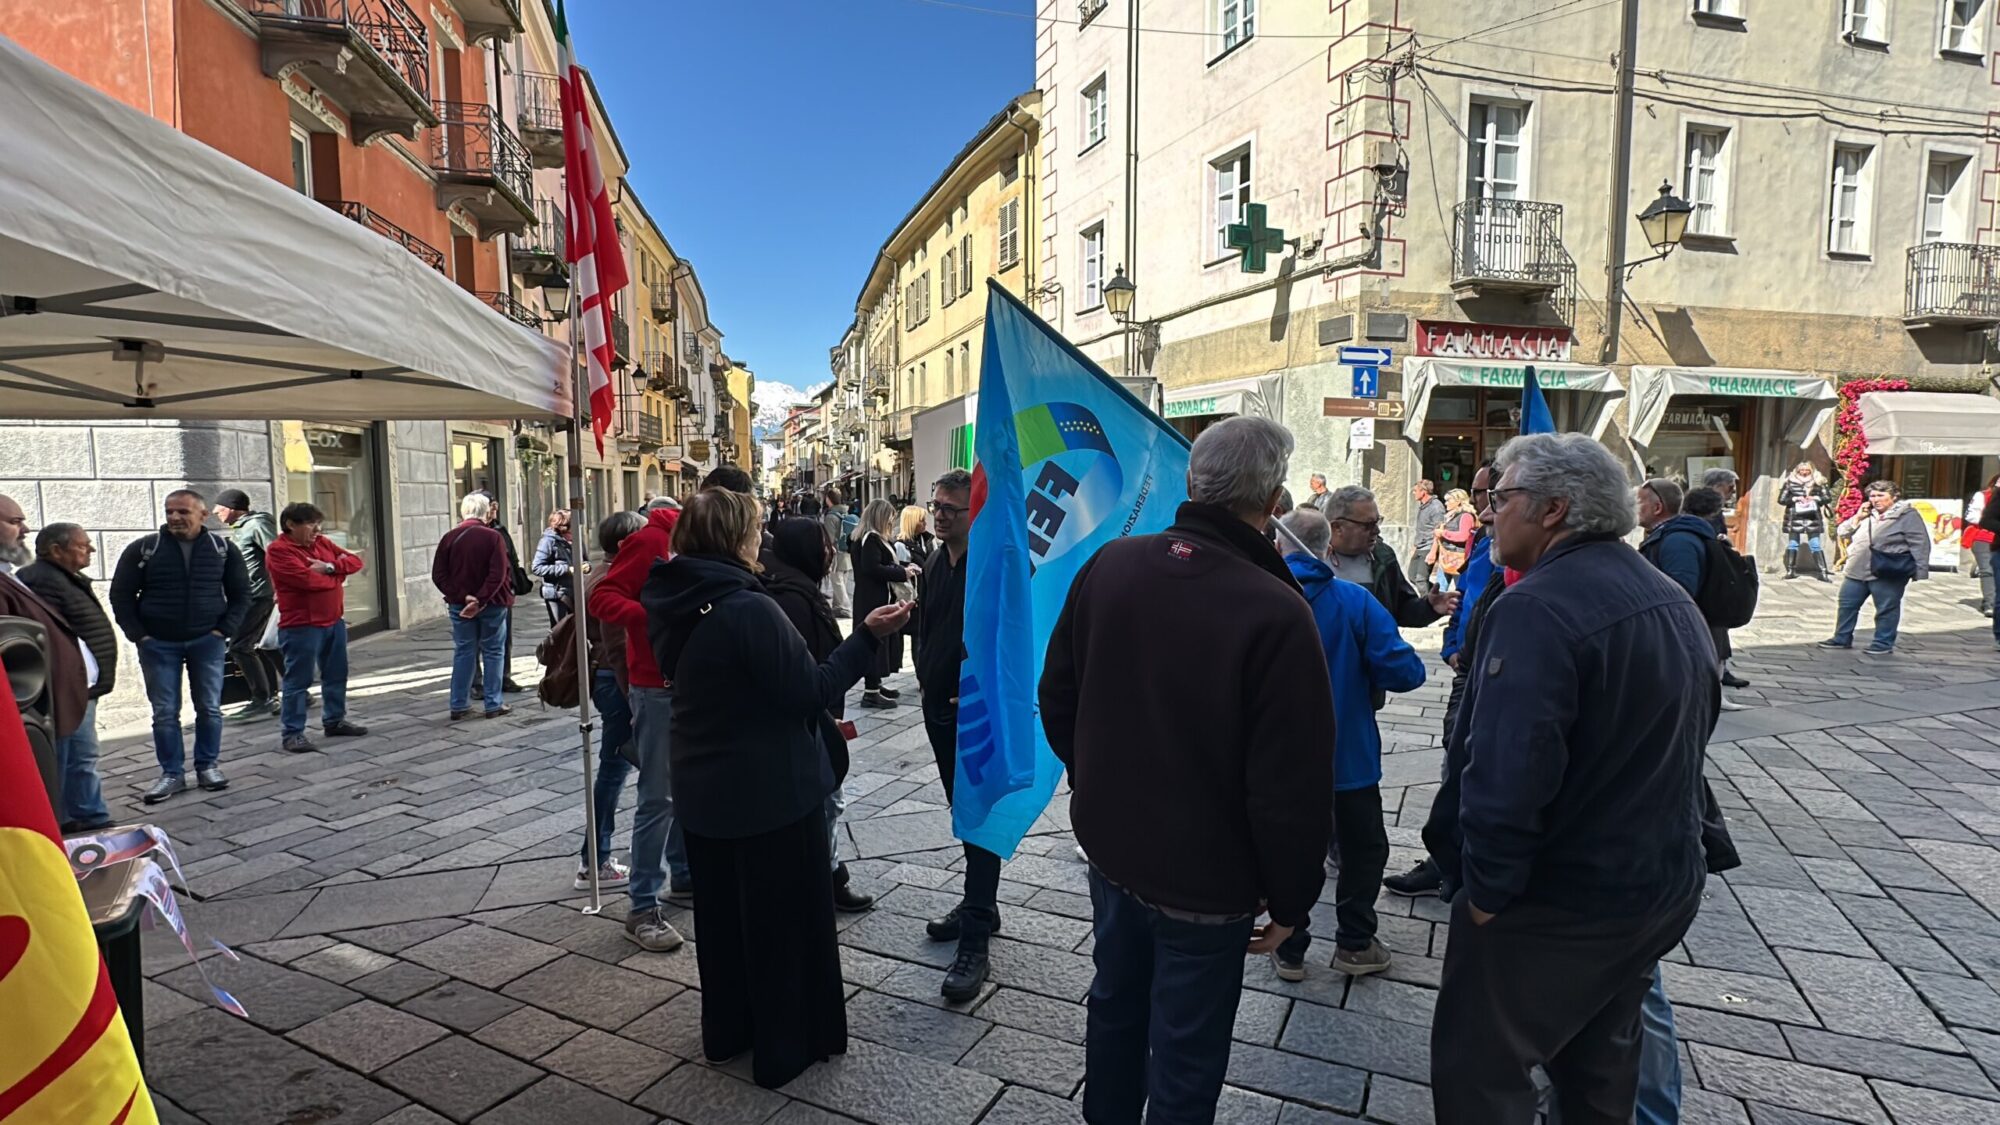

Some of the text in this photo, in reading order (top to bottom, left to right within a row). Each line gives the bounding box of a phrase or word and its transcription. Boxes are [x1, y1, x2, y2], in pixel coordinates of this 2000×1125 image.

[1480, 367, 1569, 387] FARMCIA
[1709, 376, 1798, 396] PHARMACIE
[1164, 397, 1216, 416] HARMACIE
[1661, 412, 1711, 425] FARMACIA
[306, 430, 344, 448] EOX
